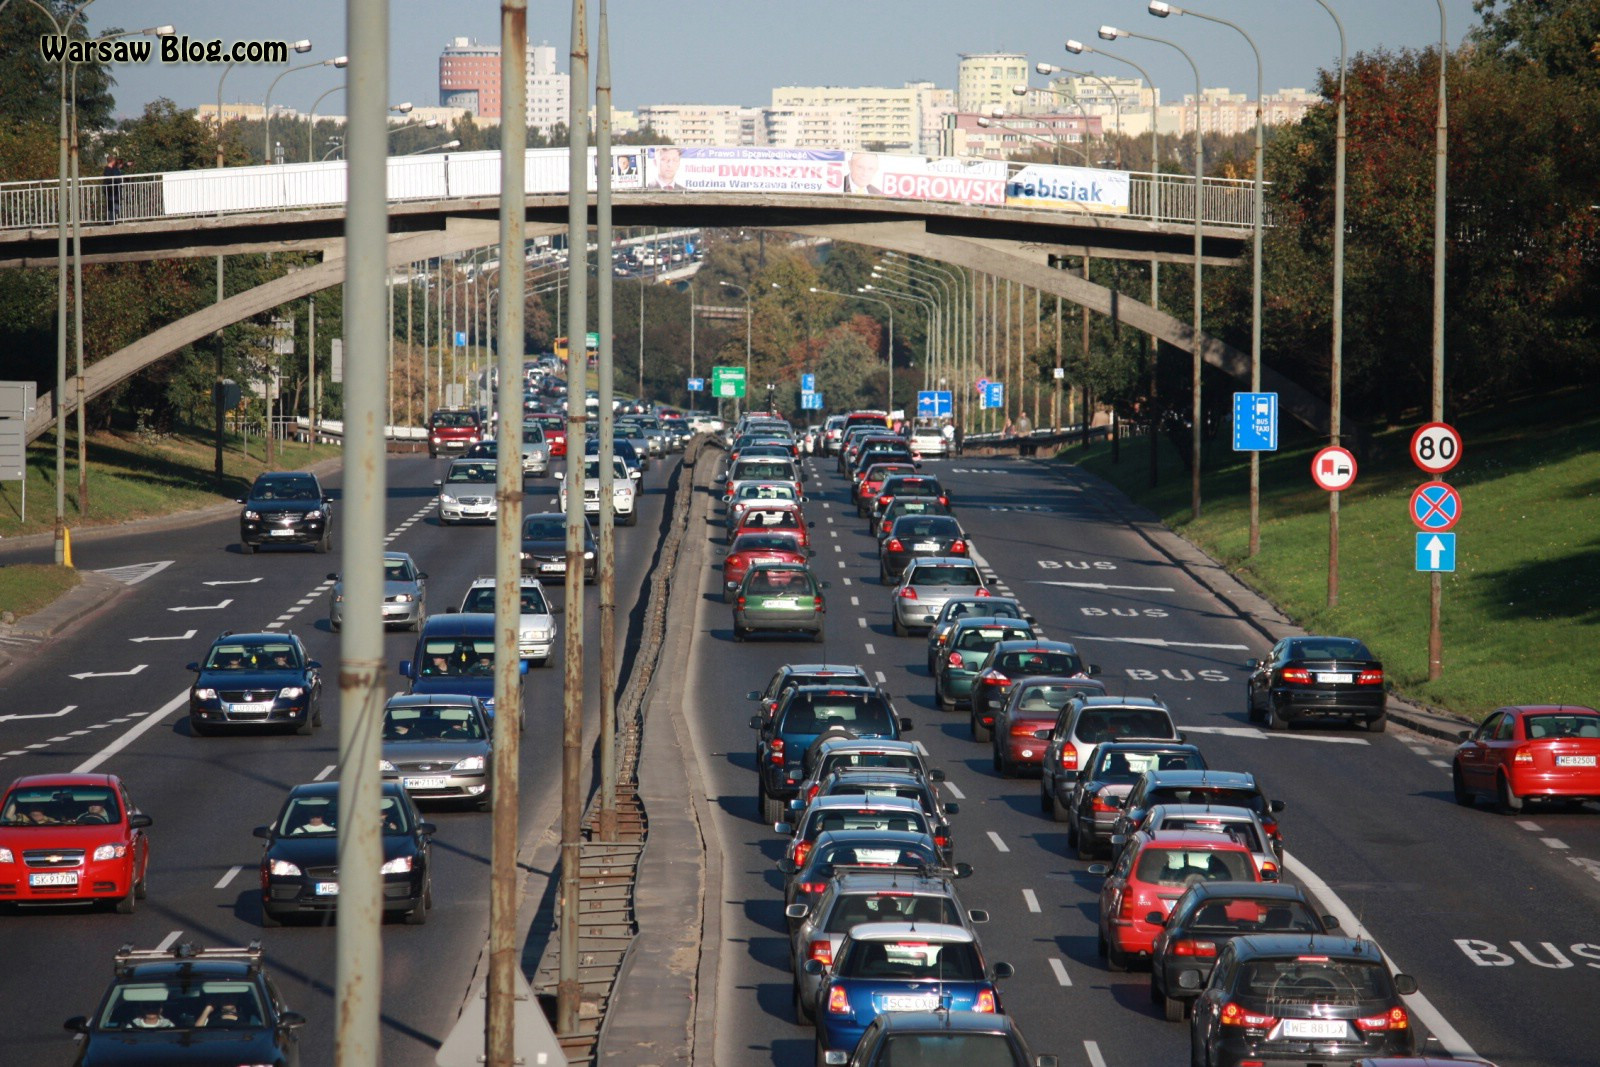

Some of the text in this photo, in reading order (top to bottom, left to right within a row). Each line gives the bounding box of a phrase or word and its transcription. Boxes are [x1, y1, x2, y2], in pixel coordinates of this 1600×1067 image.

[708, 149, 735, 159] Prawo
[826, 162, 843, 189] 5
[685, 178, 726, 188] Rodzina
[729, 179, 787, 189] Warszawa
[883, 174, 1005, 203] BOROWSKI
[1255, 425, 1270, 433] TAXI
[1419, 436, 1455, 461] 80
[1037, 559, 1118, 571] BUS
[1080, 606, 1169, 618] BUS
[1125, 668, 1231, 683] BUS
[1452, 938, 1600, 970] BUS
[889, 997, 912, 1009] SCZ
[1291, 1021, 1309, 1034] WE
